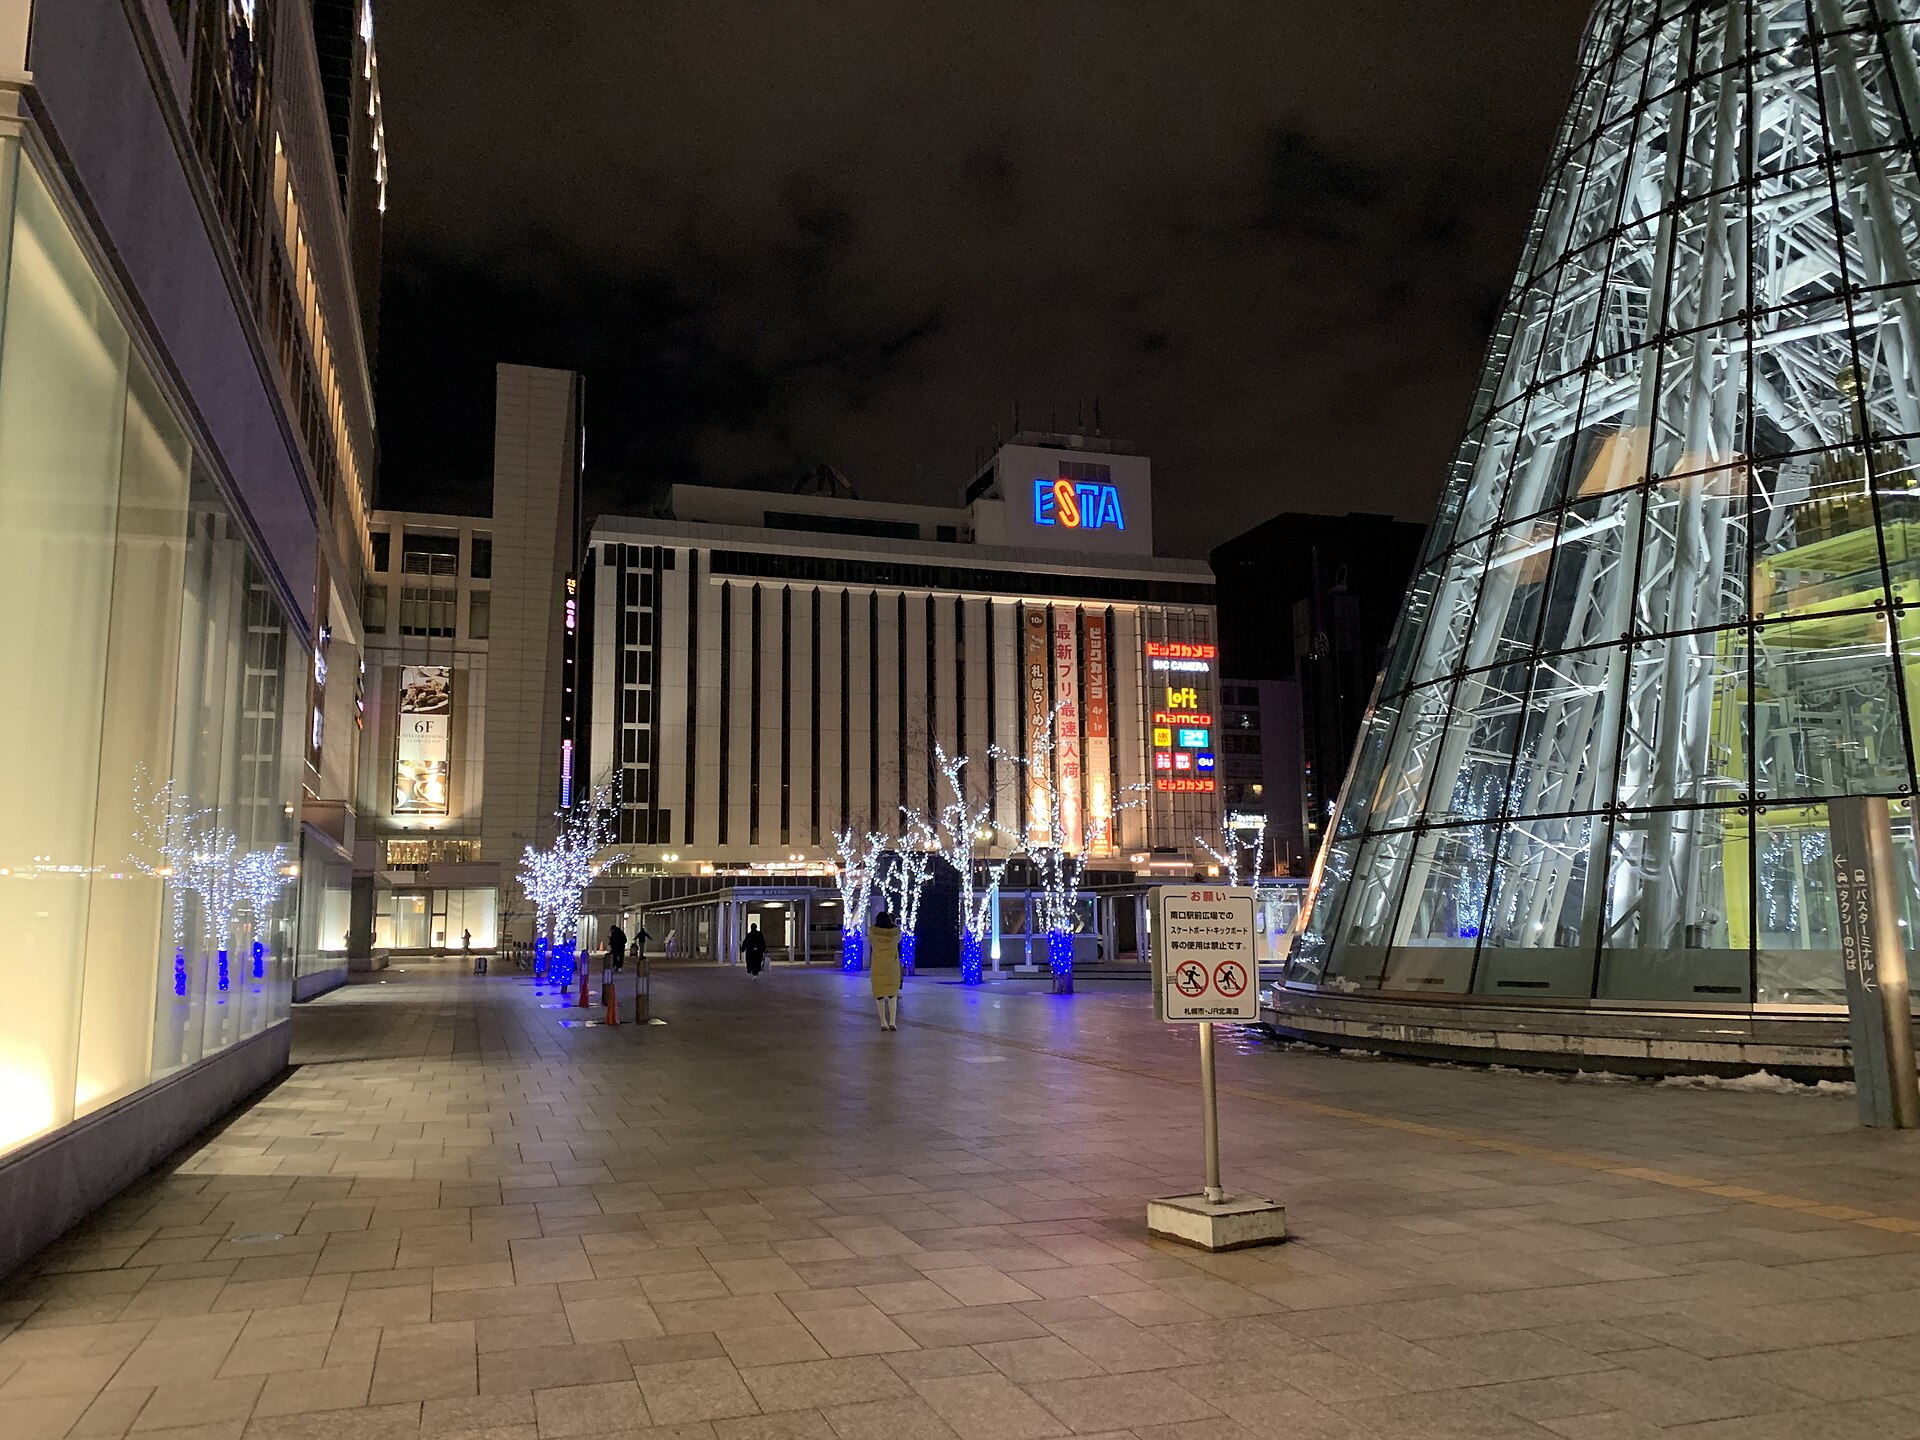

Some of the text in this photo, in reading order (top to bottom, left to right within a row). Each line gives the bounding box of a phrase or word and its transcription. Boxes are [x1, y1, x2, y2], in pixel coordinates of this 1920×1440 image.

[1034, 479, 1125, 530] ESTA
[1147, 643, 1215, 658] ビックカメラ
[1167, 687, 1198, 709] Loft
[1155, 713, 1211, 725] namco
[414, 720, 435, 733] 6F
[1198, 757, 1214, 766] GU
[1157, 779, 1215, 791] ビックカメラ
[1191, 891, 1226, 902] お願い
[1170, 911, 1234, 920] 南口駅前広場での
[1839, 890, 1857, 970] タクシーのりば
[1856, 889, 1874, 971] バスターミナル
[1171, 941, 1247, 950] 等の使用は禁止です。
